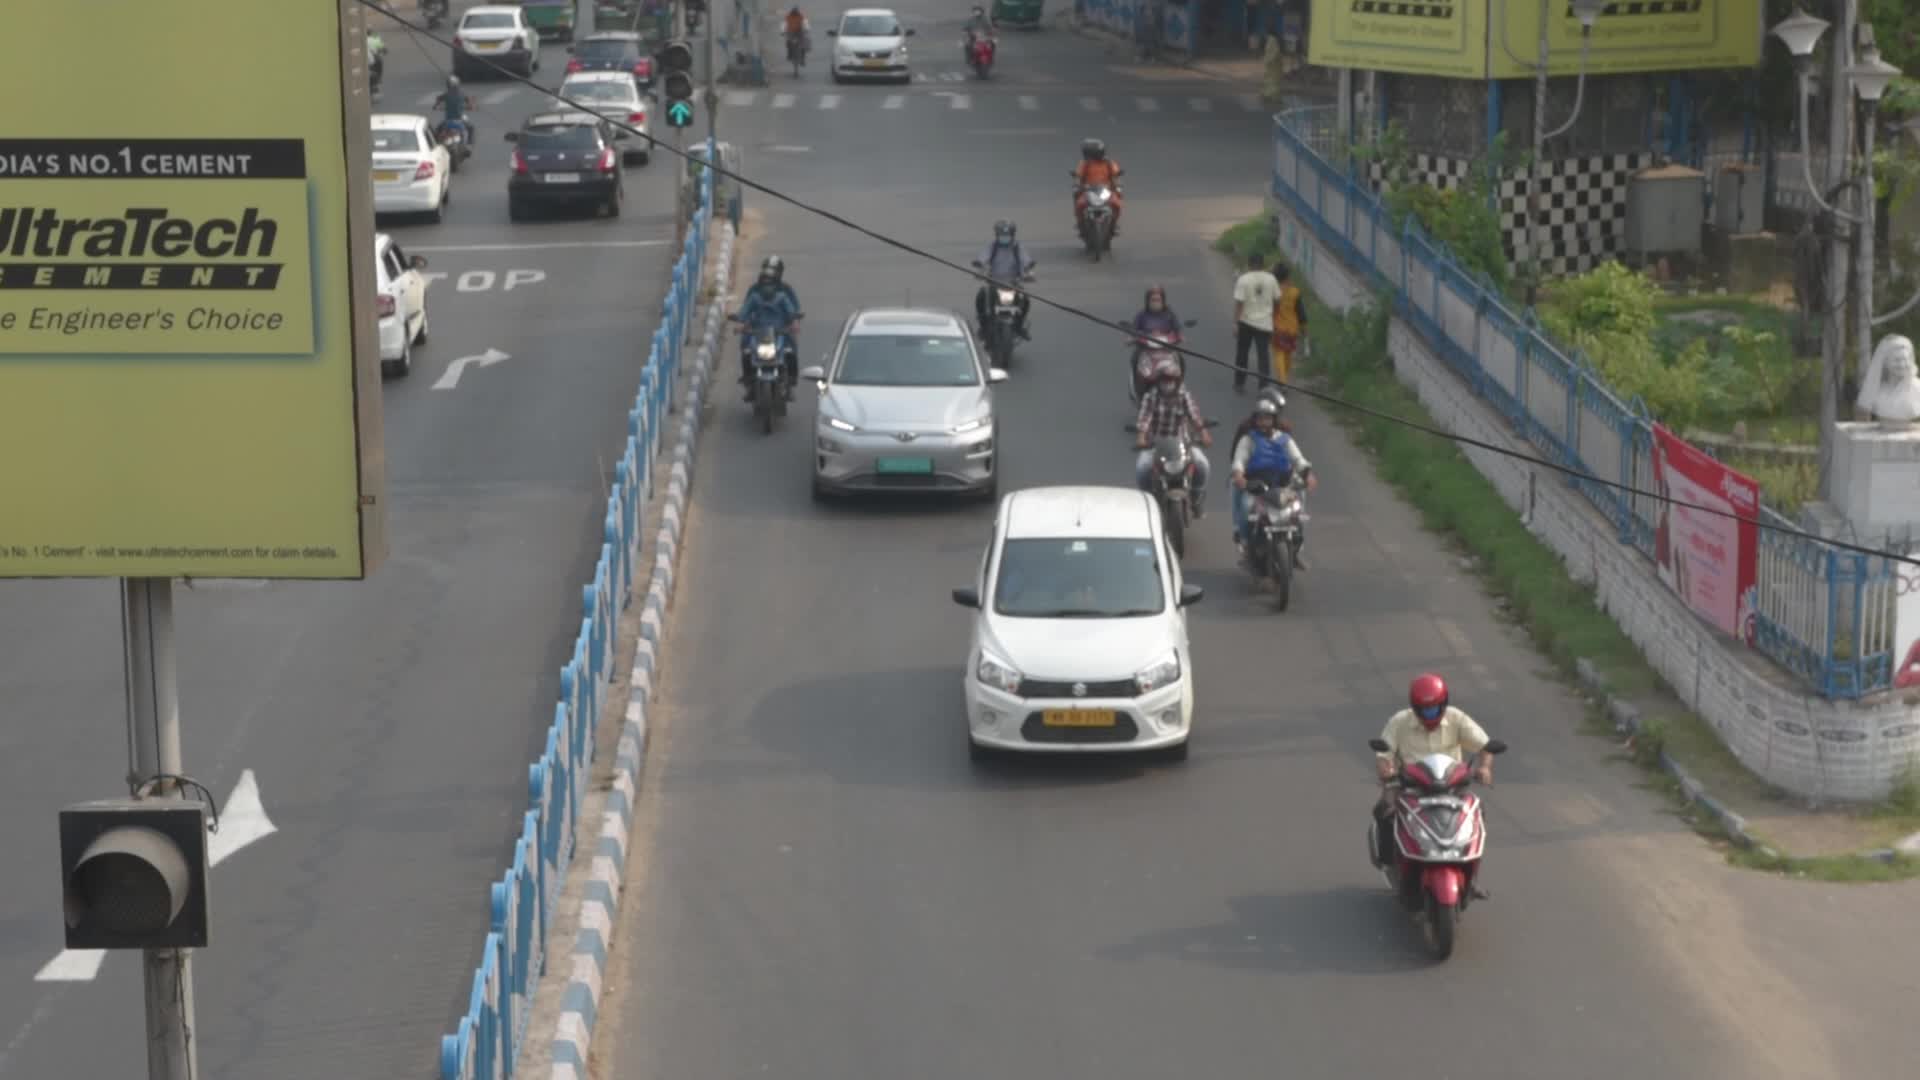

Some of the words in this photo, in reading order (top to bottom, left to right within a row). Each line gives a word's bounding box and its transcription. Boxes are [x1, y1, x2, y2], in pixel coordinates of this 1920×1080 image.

[141, 154, 252, 174] CEMENT
[29, 307, 174, 334] Engineer's
[187, 307, 284, 330] Choice
